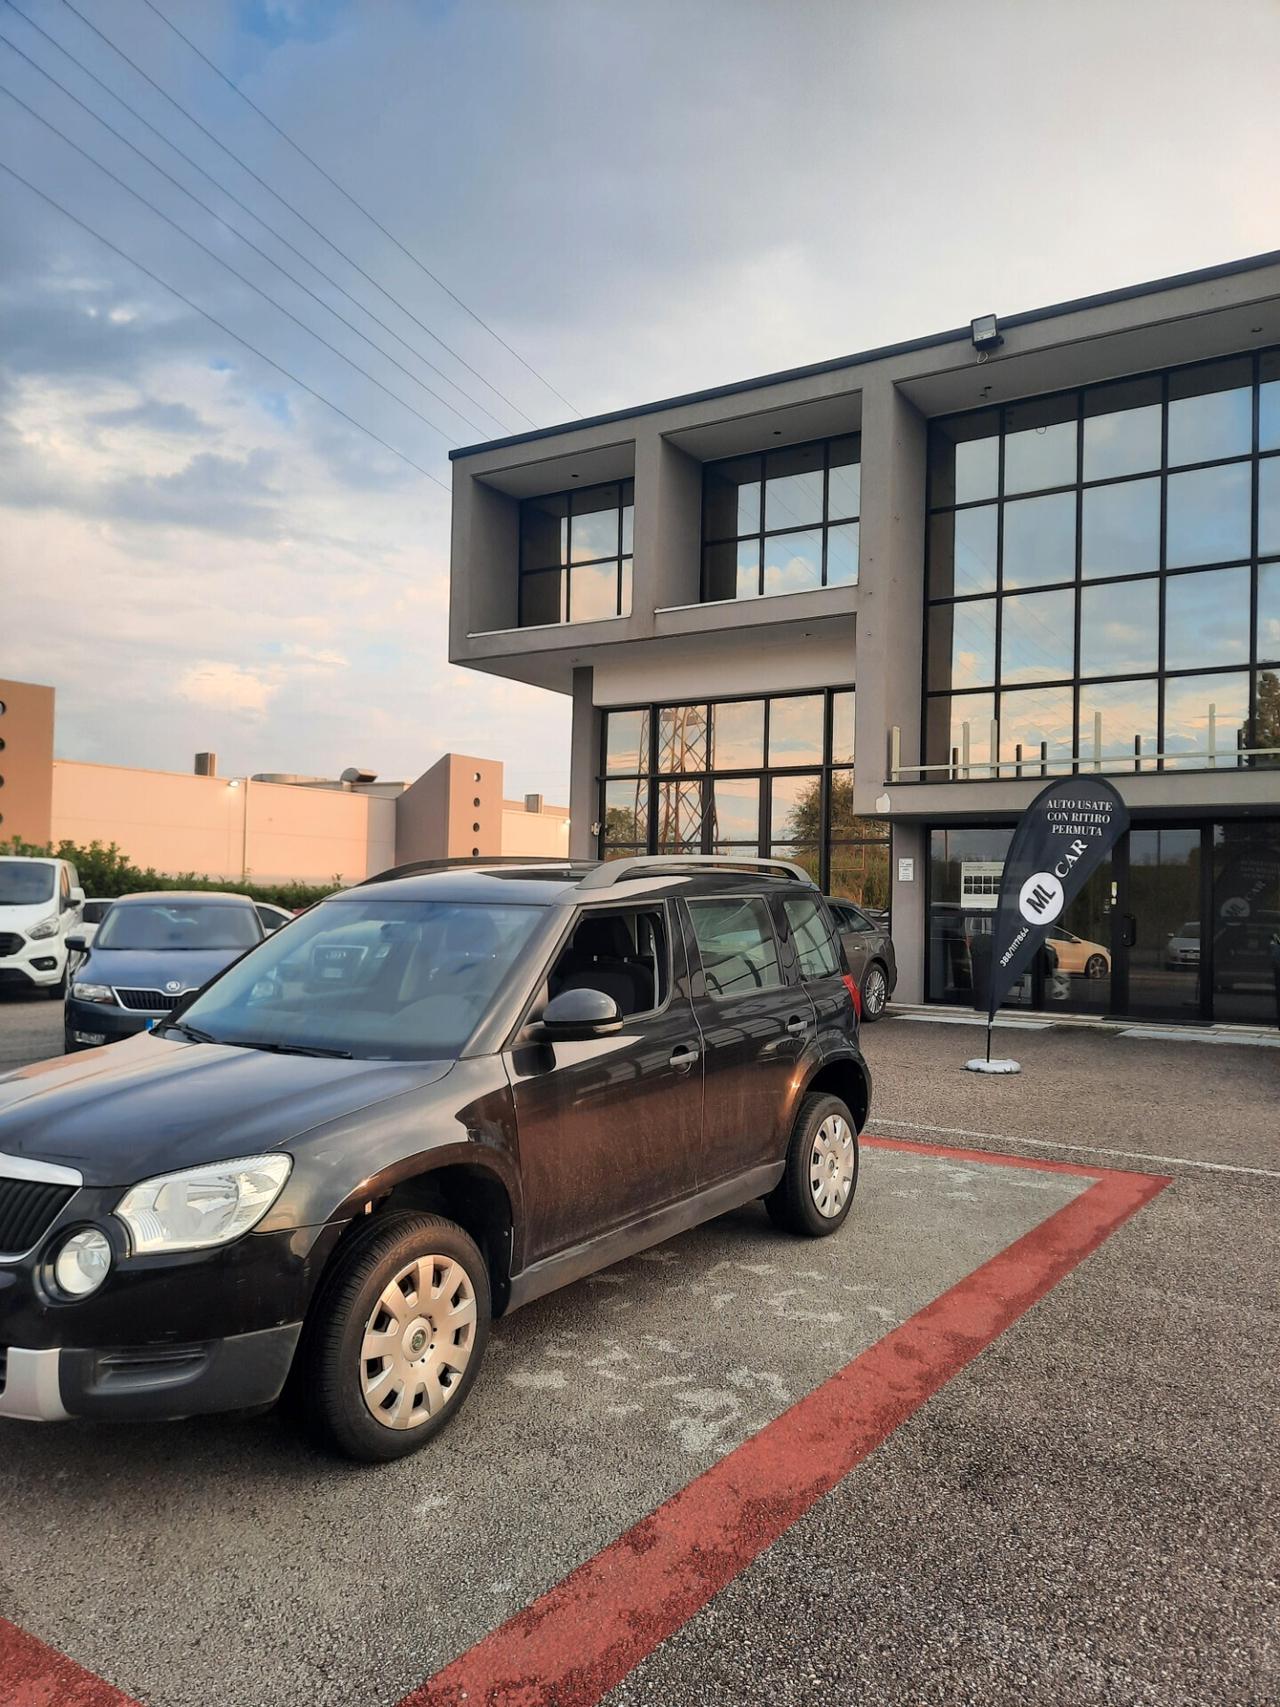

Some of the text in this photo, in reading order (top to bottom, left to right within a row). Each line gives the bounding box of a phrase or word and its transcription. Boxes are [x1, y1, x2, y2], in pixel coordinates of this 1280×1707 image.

[1046, 799, 1113, 812] AUTO USATE
[1047, 811, 1111, 824] CON RITIRO
[1051, 824, 1103, 836] PERMUTA
[1025, 839, 1089, 915] ML CAR
